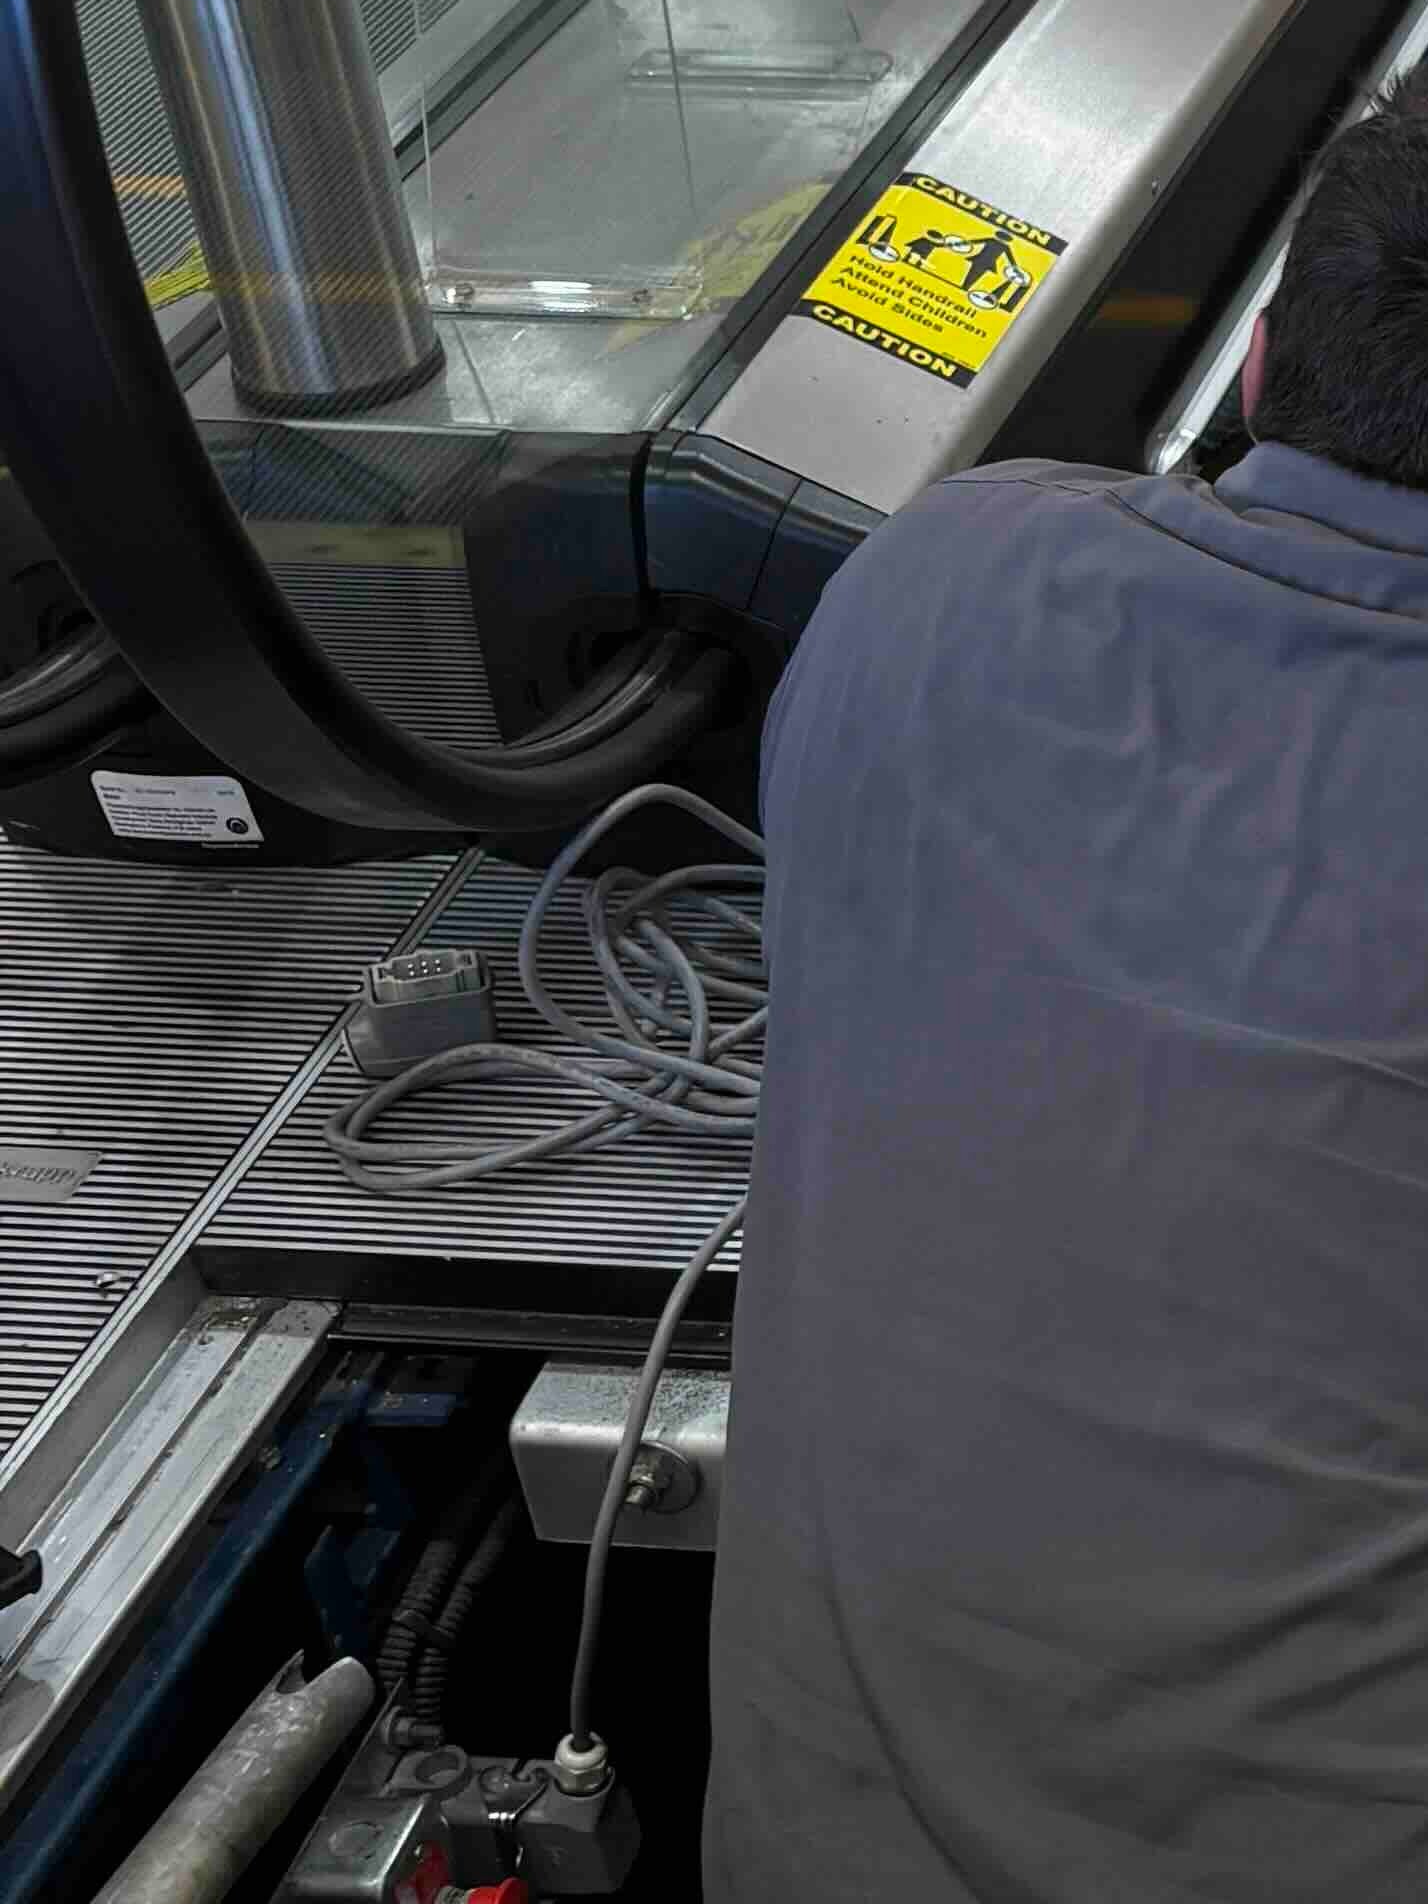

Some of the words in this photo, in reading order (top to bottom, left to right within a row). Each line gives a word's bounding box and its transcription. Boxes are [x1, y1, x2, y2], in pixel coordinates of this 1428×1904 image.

[913, 175, 1050, 247] CAUTION
[830, 276, 887, 307] Avoid
[893, 302, 945, 335] Sides
[839, 267, 906, 303] Attend
[907, 296, 988, 339] Children
[848, 253, 895, 280] Hold
[897, 273, 977, 320] Handrail
[812, 304, 956, 379] CAUTION
